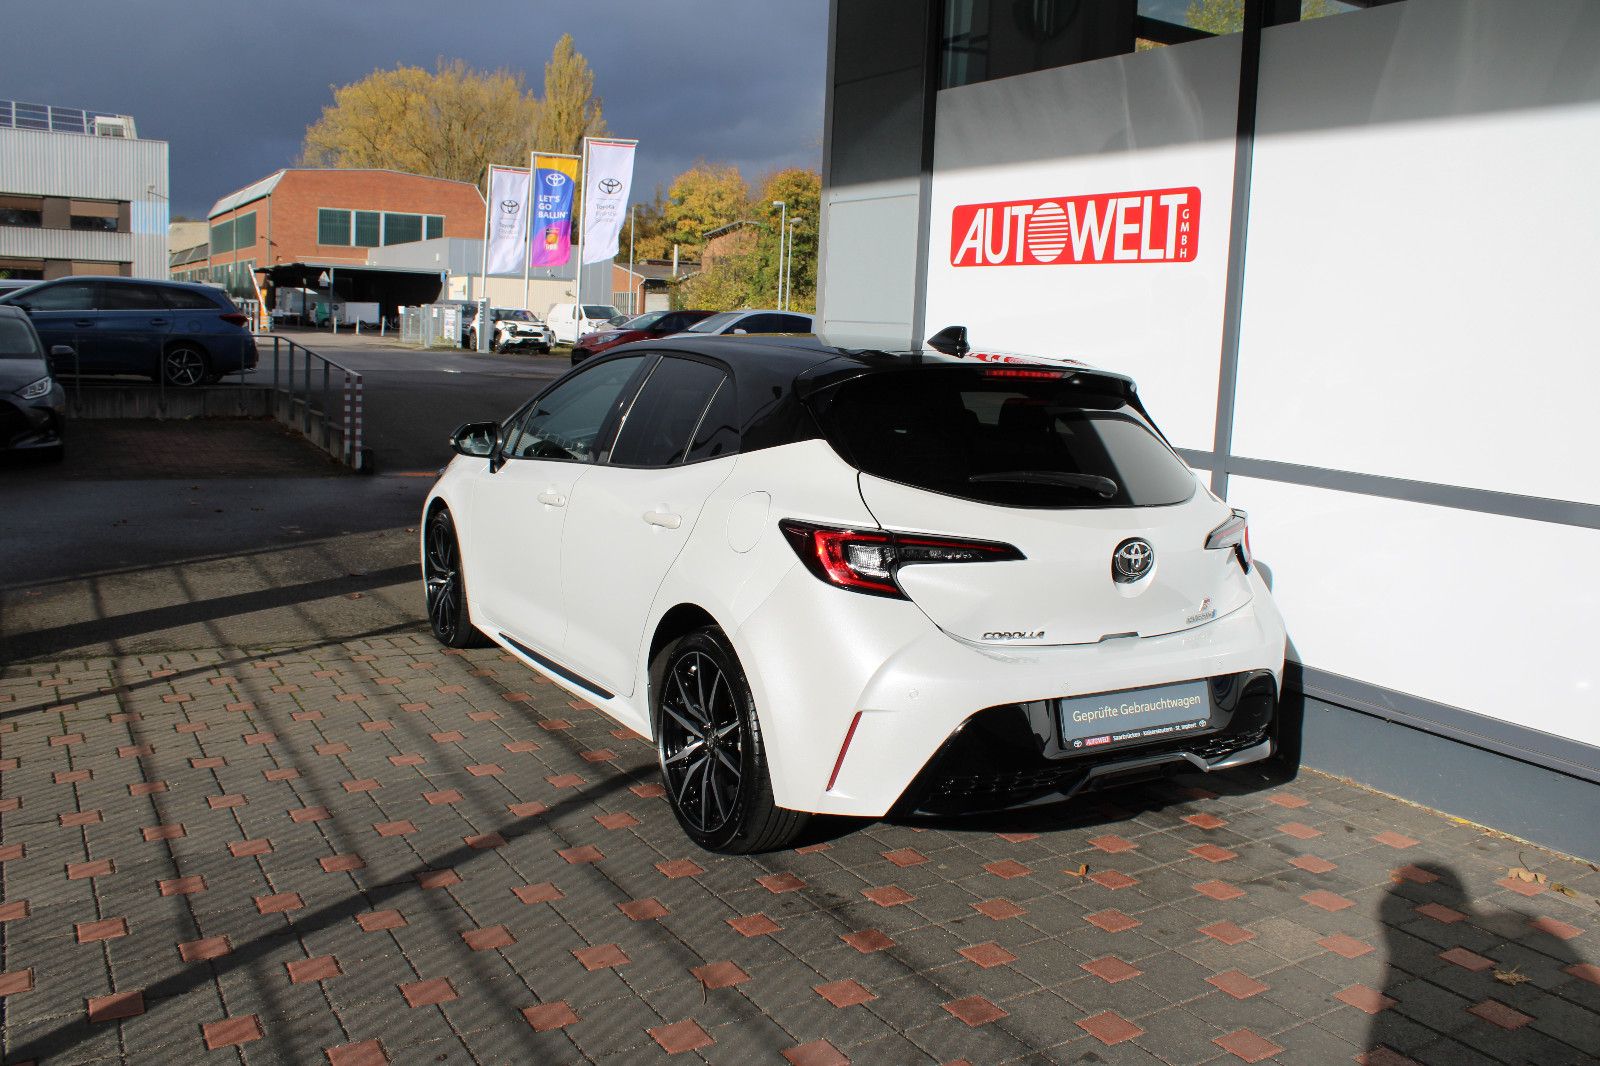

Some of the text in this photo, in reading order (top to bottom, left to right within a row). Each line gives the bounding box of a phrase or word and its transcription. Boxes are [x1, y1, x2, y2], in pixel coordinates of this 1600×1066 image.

[539, 194, 561, 203] LET'S
[953, 193, 1188, 265] AUTOWELT
[1179, 208, 1190, 259] GMBH
[980, 631, 1045, 640] COROLLA
[1072, 694, 1201, 724] Geprüfte Gebrauchtwagen
